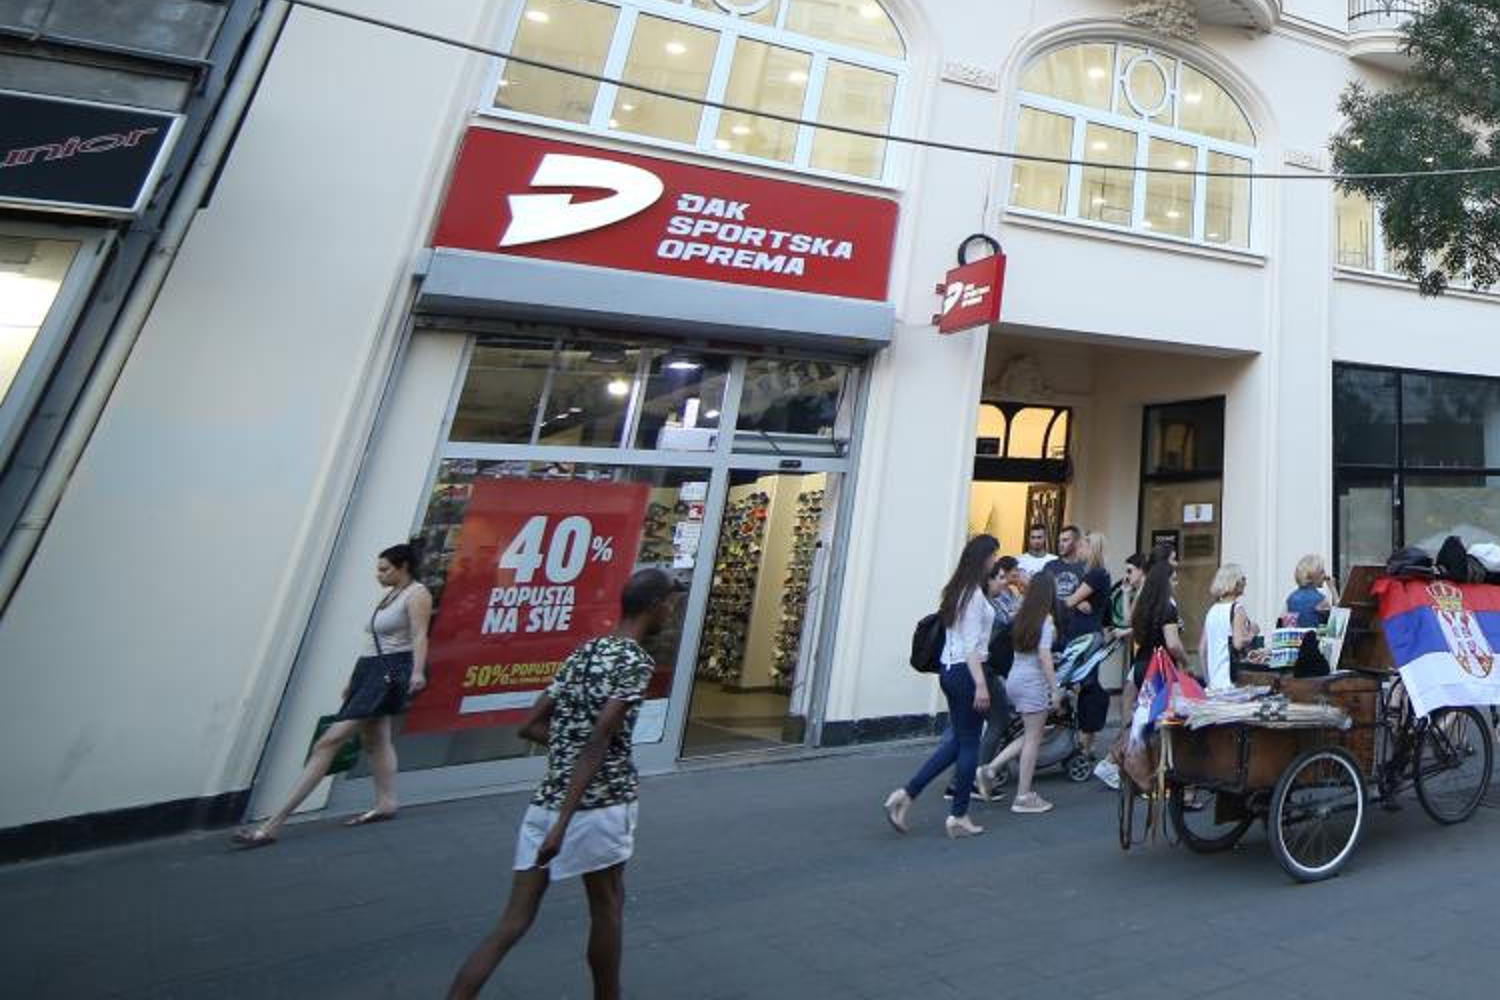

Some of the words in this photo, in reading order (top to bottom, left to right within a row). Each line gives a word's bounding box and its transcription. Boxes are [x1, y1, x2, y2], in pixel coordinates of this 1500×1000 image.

[666, 217, 855, 260] SPORTSKA
[656, 239, 806, 276] OPREMA
[488, 585, 575, 608] POPUSTA
[481, 605, 519, 635] NA
[525, 604, 574, 633] SVE
[463, 663, 510, 687] 50%
[511, 662, 561, 675] POPUST
